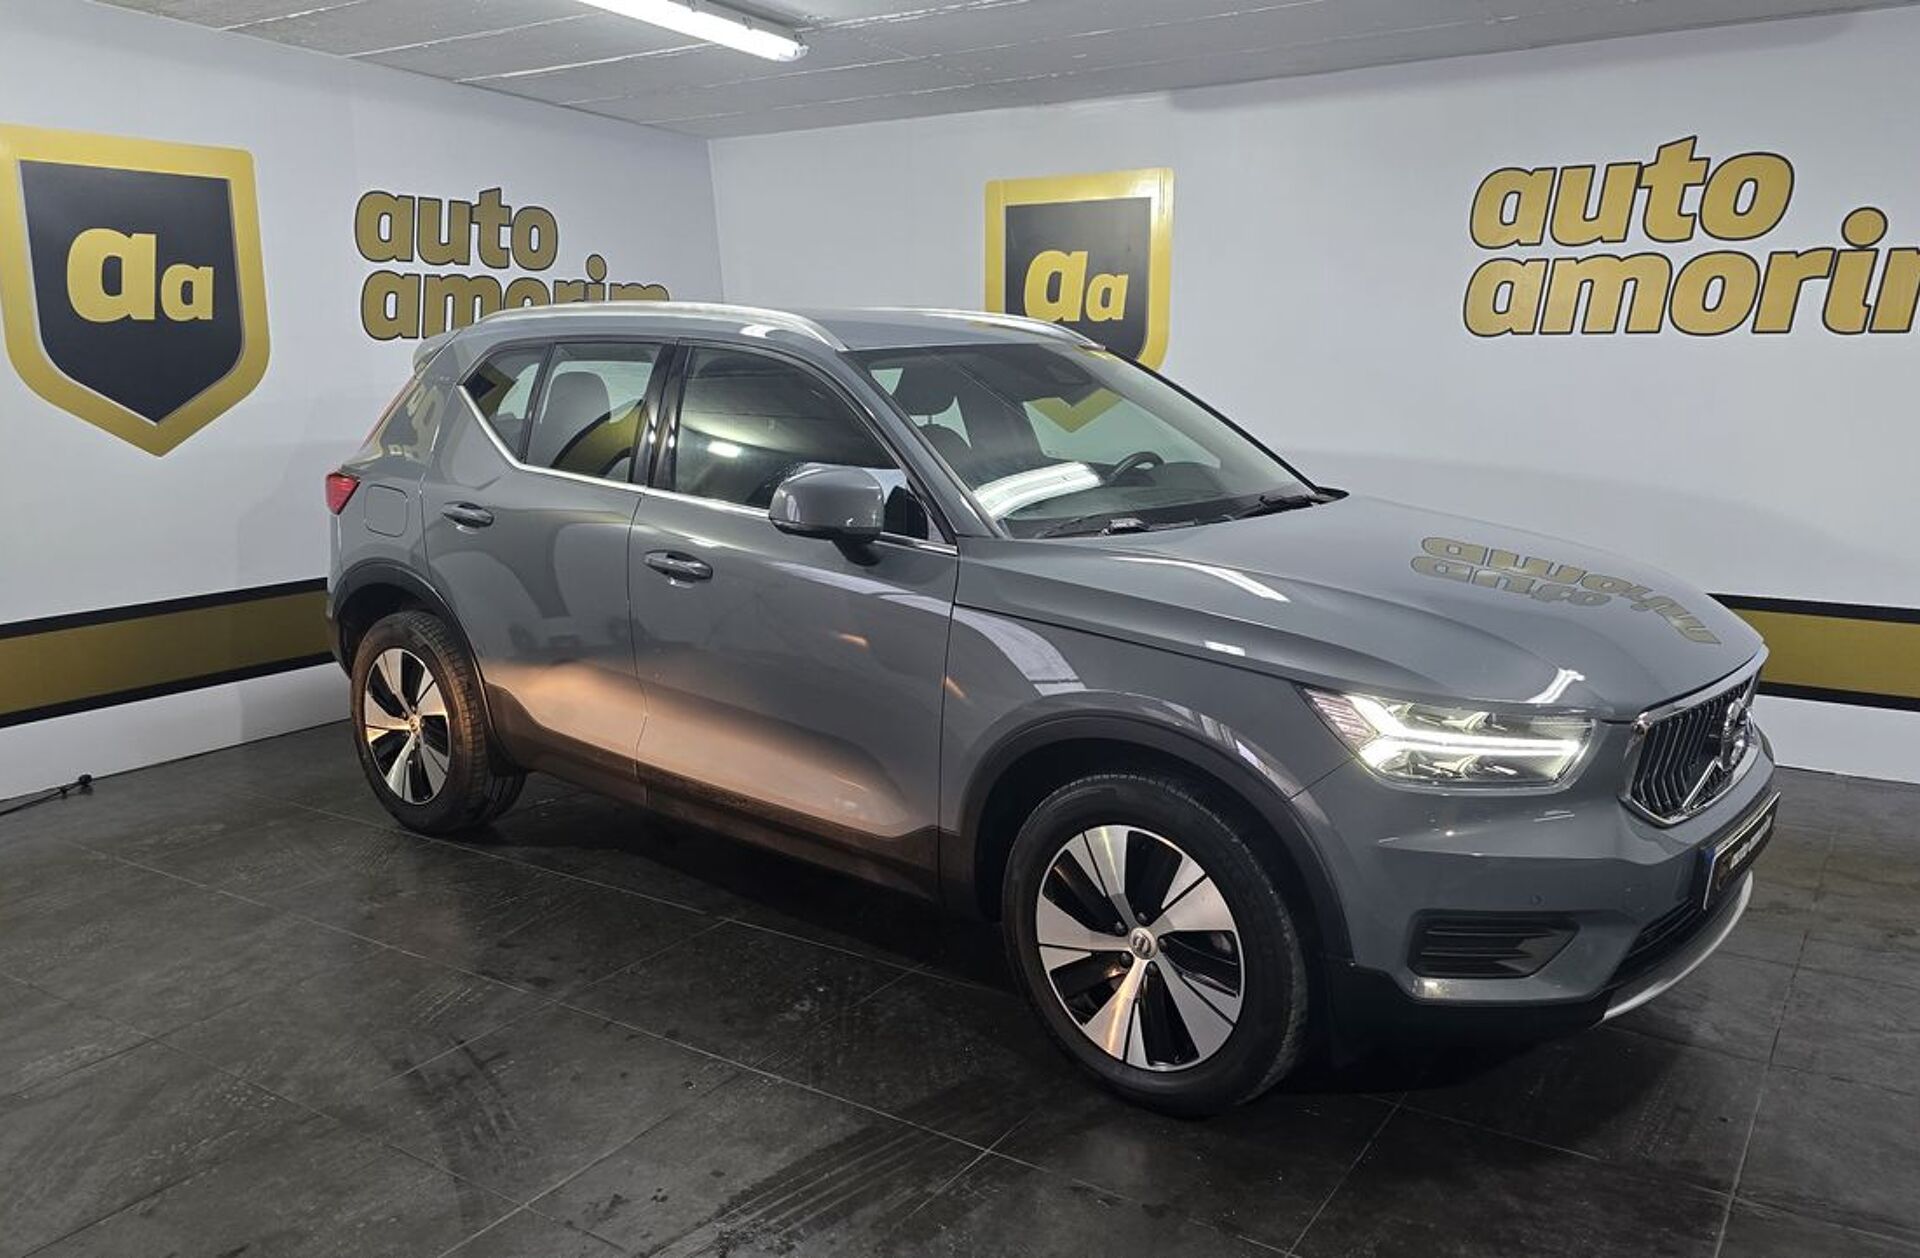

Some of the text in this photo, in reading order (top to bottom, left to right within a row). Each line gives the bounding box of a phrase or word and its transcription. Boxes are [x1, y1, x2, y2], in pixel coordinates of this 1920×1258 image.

[354, 187, 559, 271] auto
[1469, 135, 1795, 249] auto
[66, 227, 215, 324] aa
[360, 254, 671, 340] ami
[1023, 249, 1130, 323] aa
